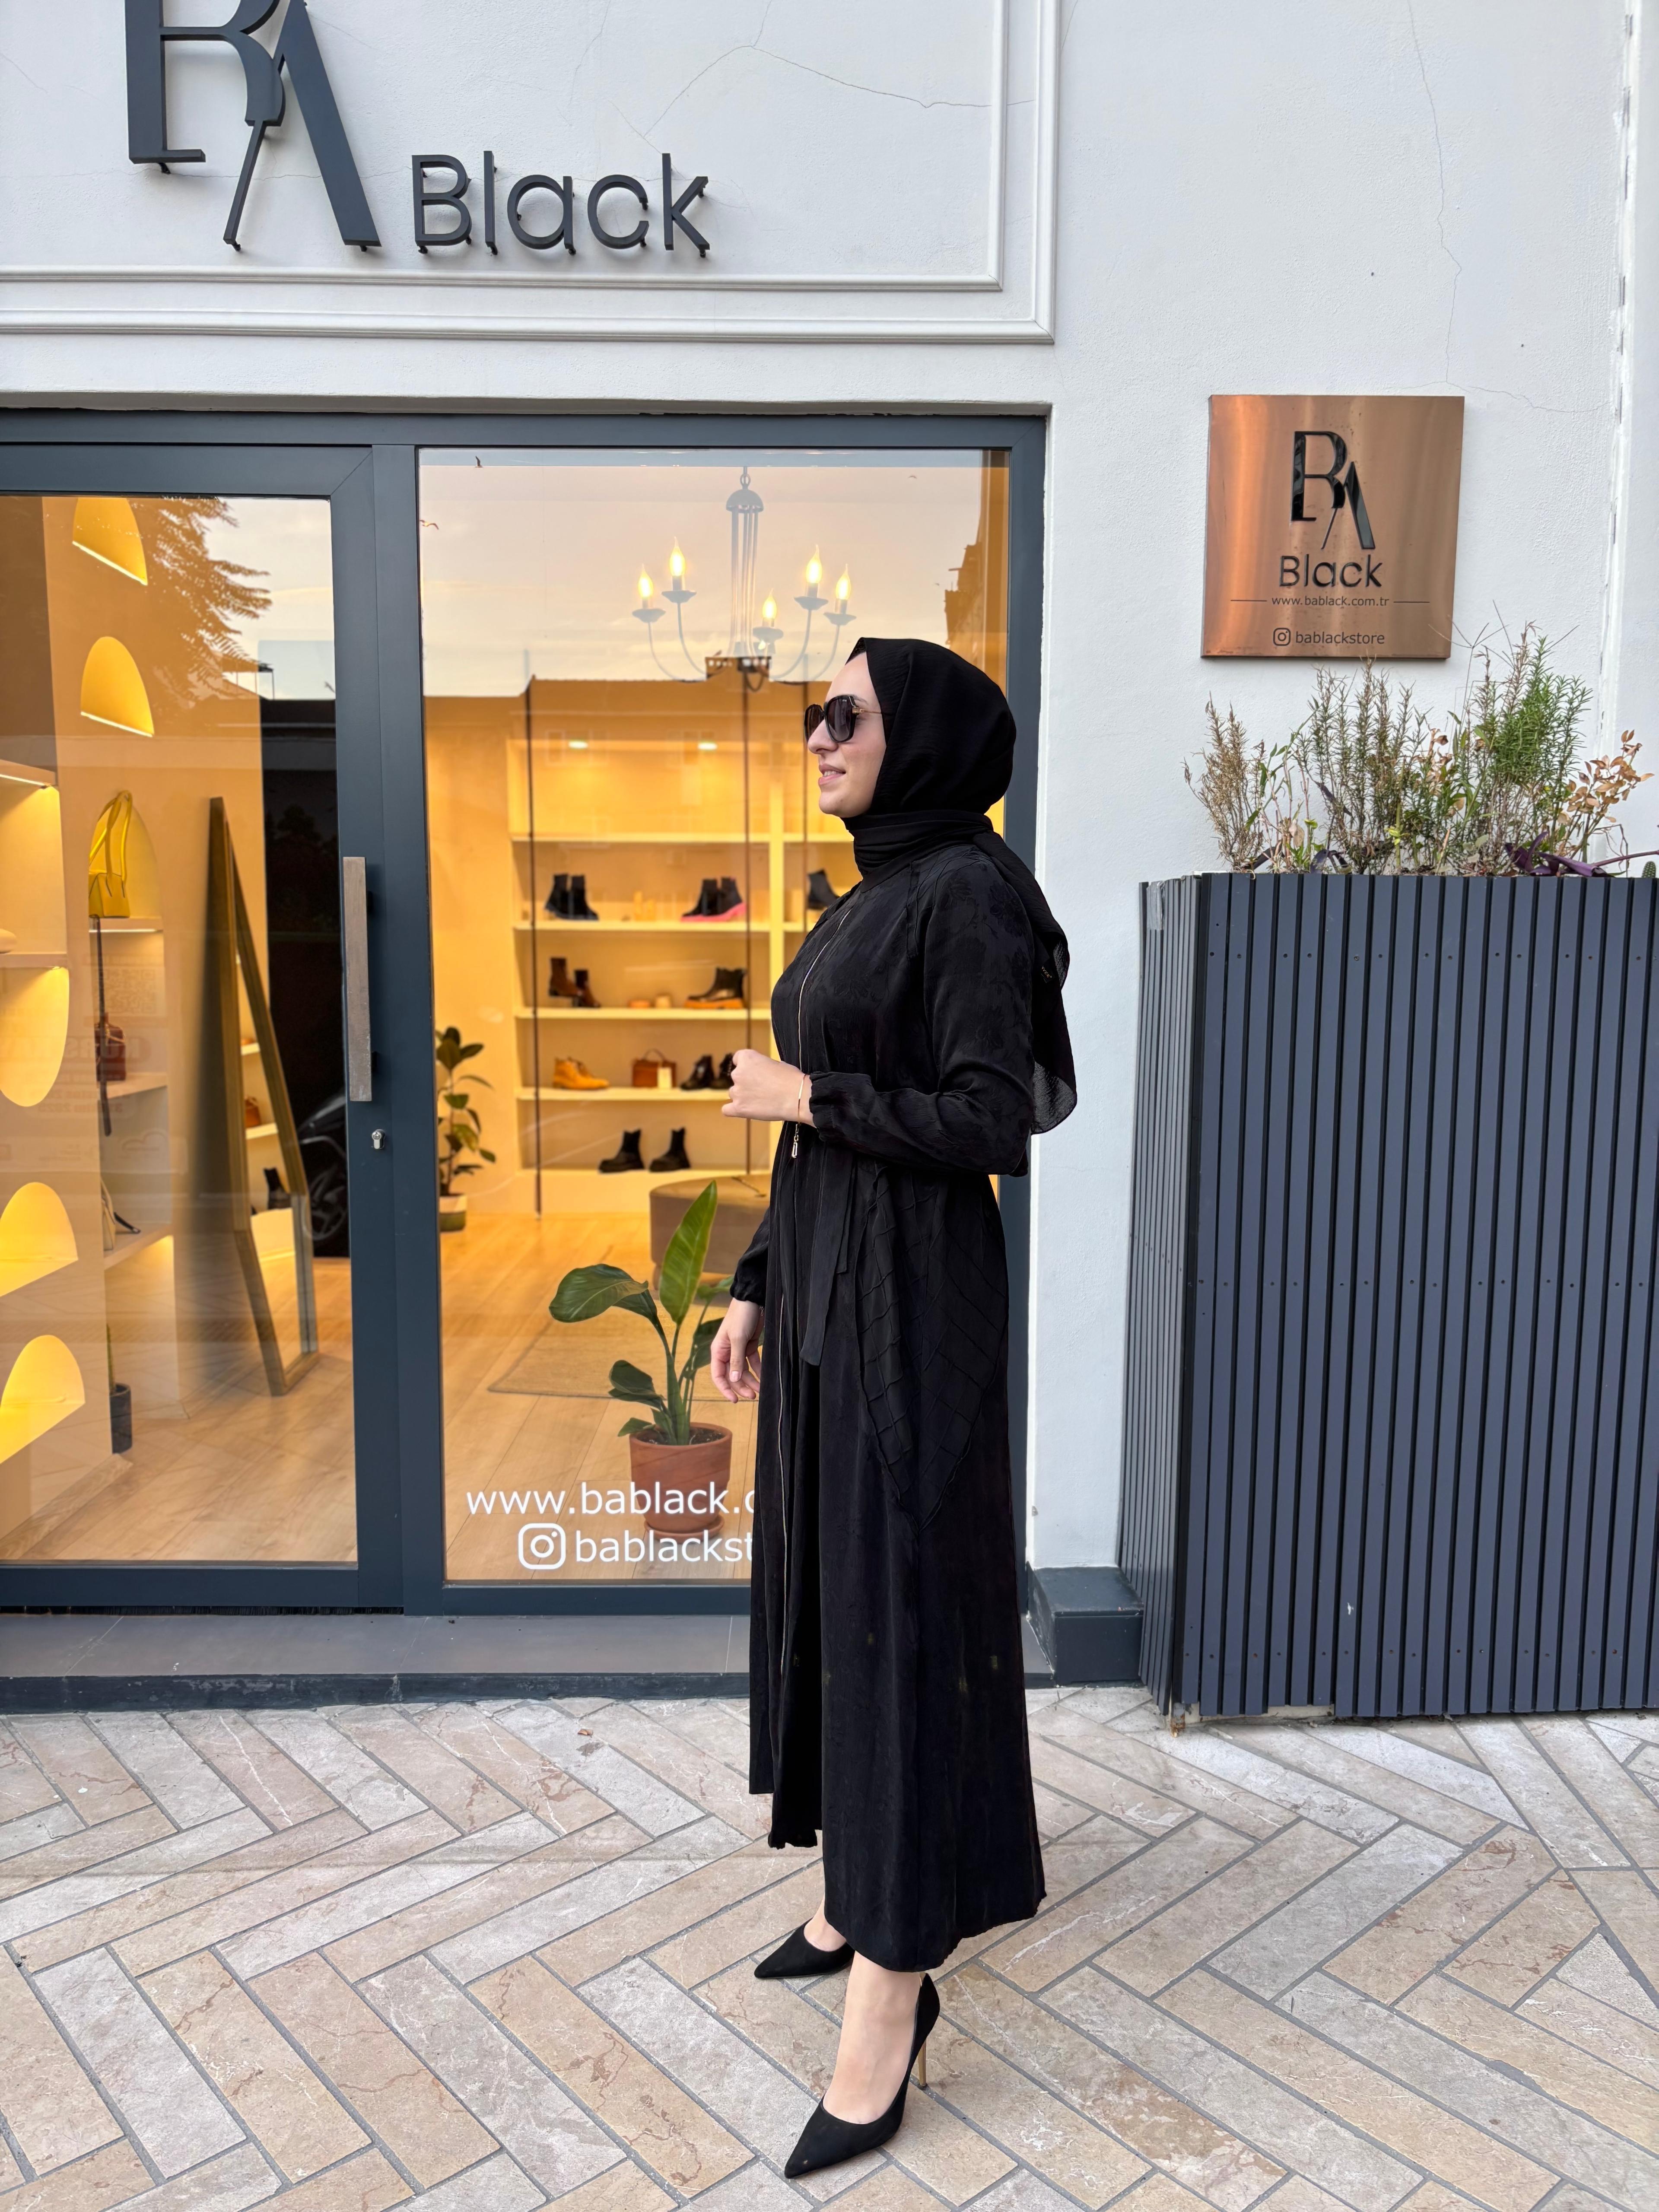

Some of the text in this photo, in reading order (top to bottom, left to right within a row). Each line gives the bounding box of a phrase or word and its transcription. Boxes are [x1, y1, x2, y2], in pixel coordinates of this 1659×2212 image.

[411, 150, 711, 251] Black
[1279, 554, 1383, 587] Black
[1271, 596, 1389, 607] www.bablack.com.tr
[1296, 632, 1385, 644] bablackstore
